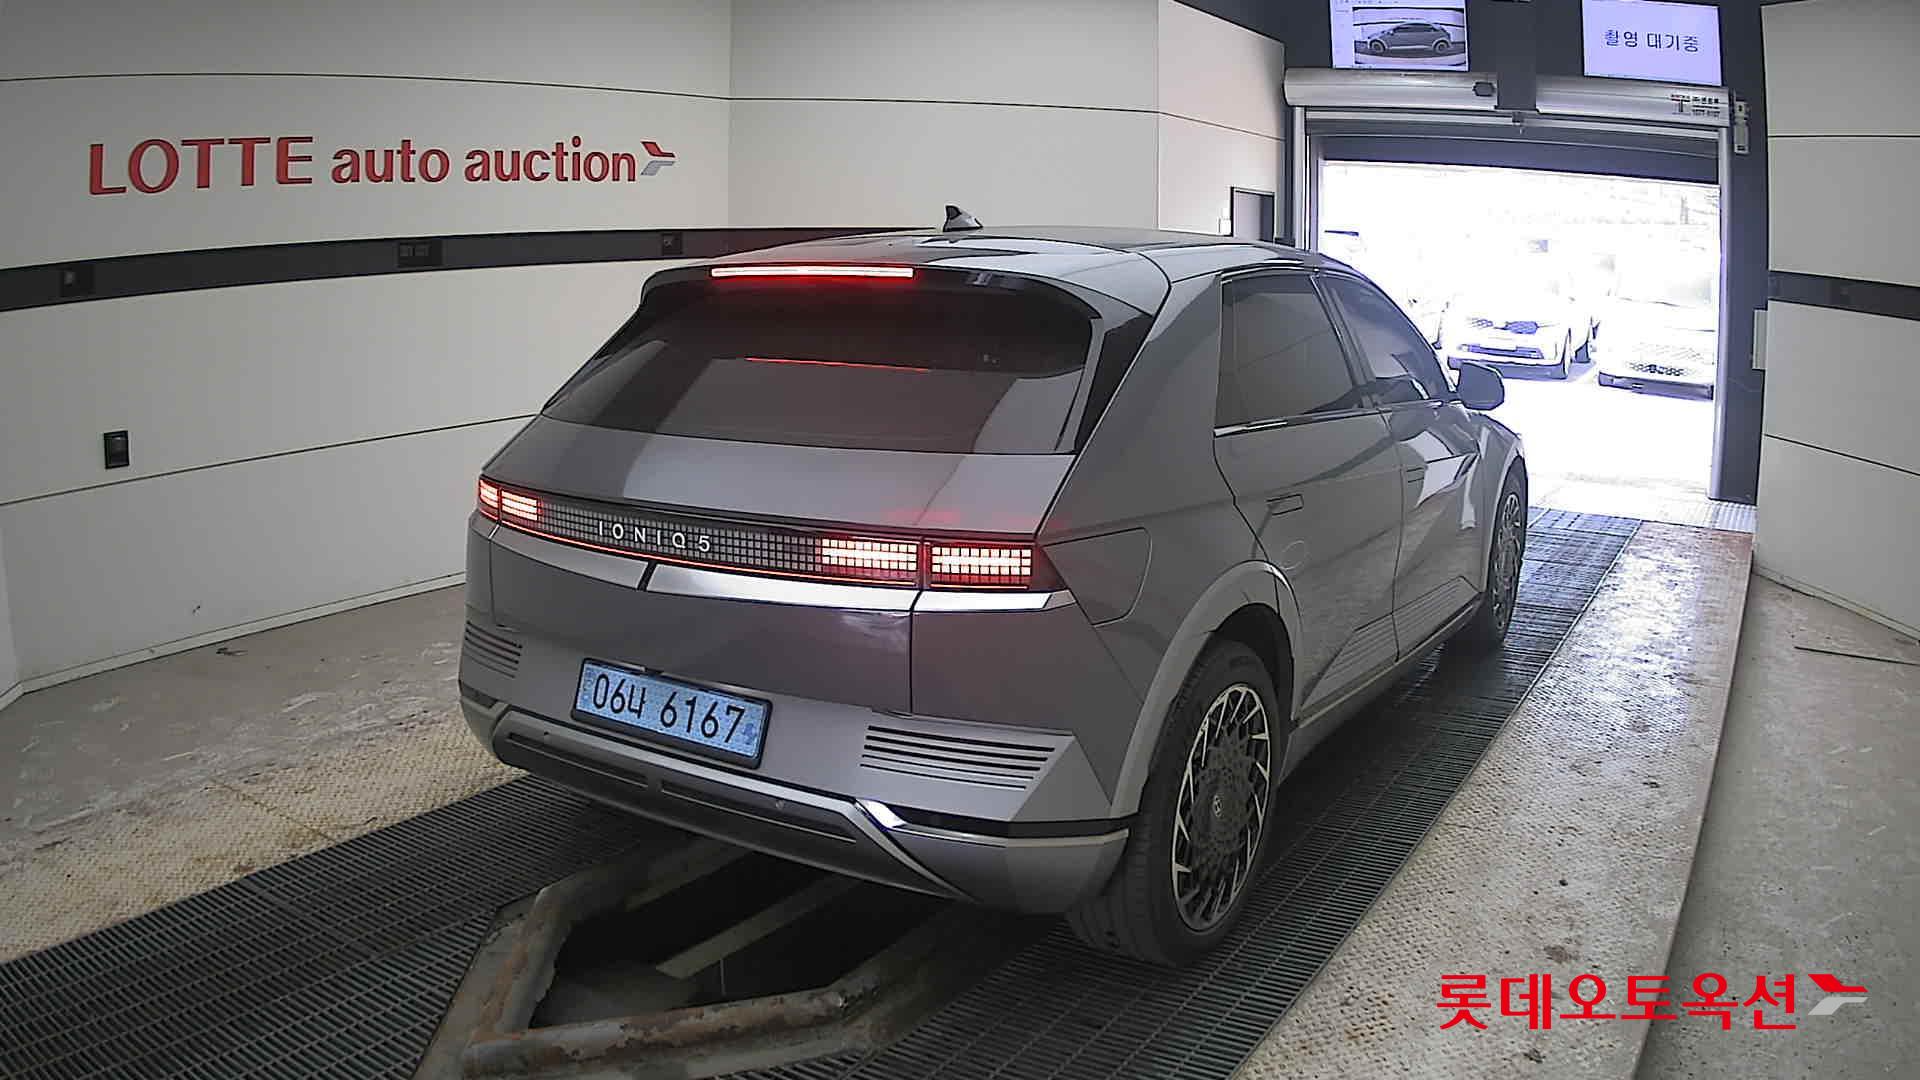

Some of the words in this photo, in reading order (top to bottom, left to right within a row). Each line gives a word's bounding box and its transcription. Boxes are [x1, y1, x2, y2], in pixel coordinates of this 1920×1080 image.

[1646, 32, 1698, 52] 대기중
[89, 137, 313, 195] LOTTE
[331, 139, 450, 183] auto
[463, 136, 637, 183] auction
[598, 520, 686, 549] IONIQ
[698, 535, 711, 553] 5
[592, 673, 646, 719] 06나
[660, 691, 746, 743] 6167
